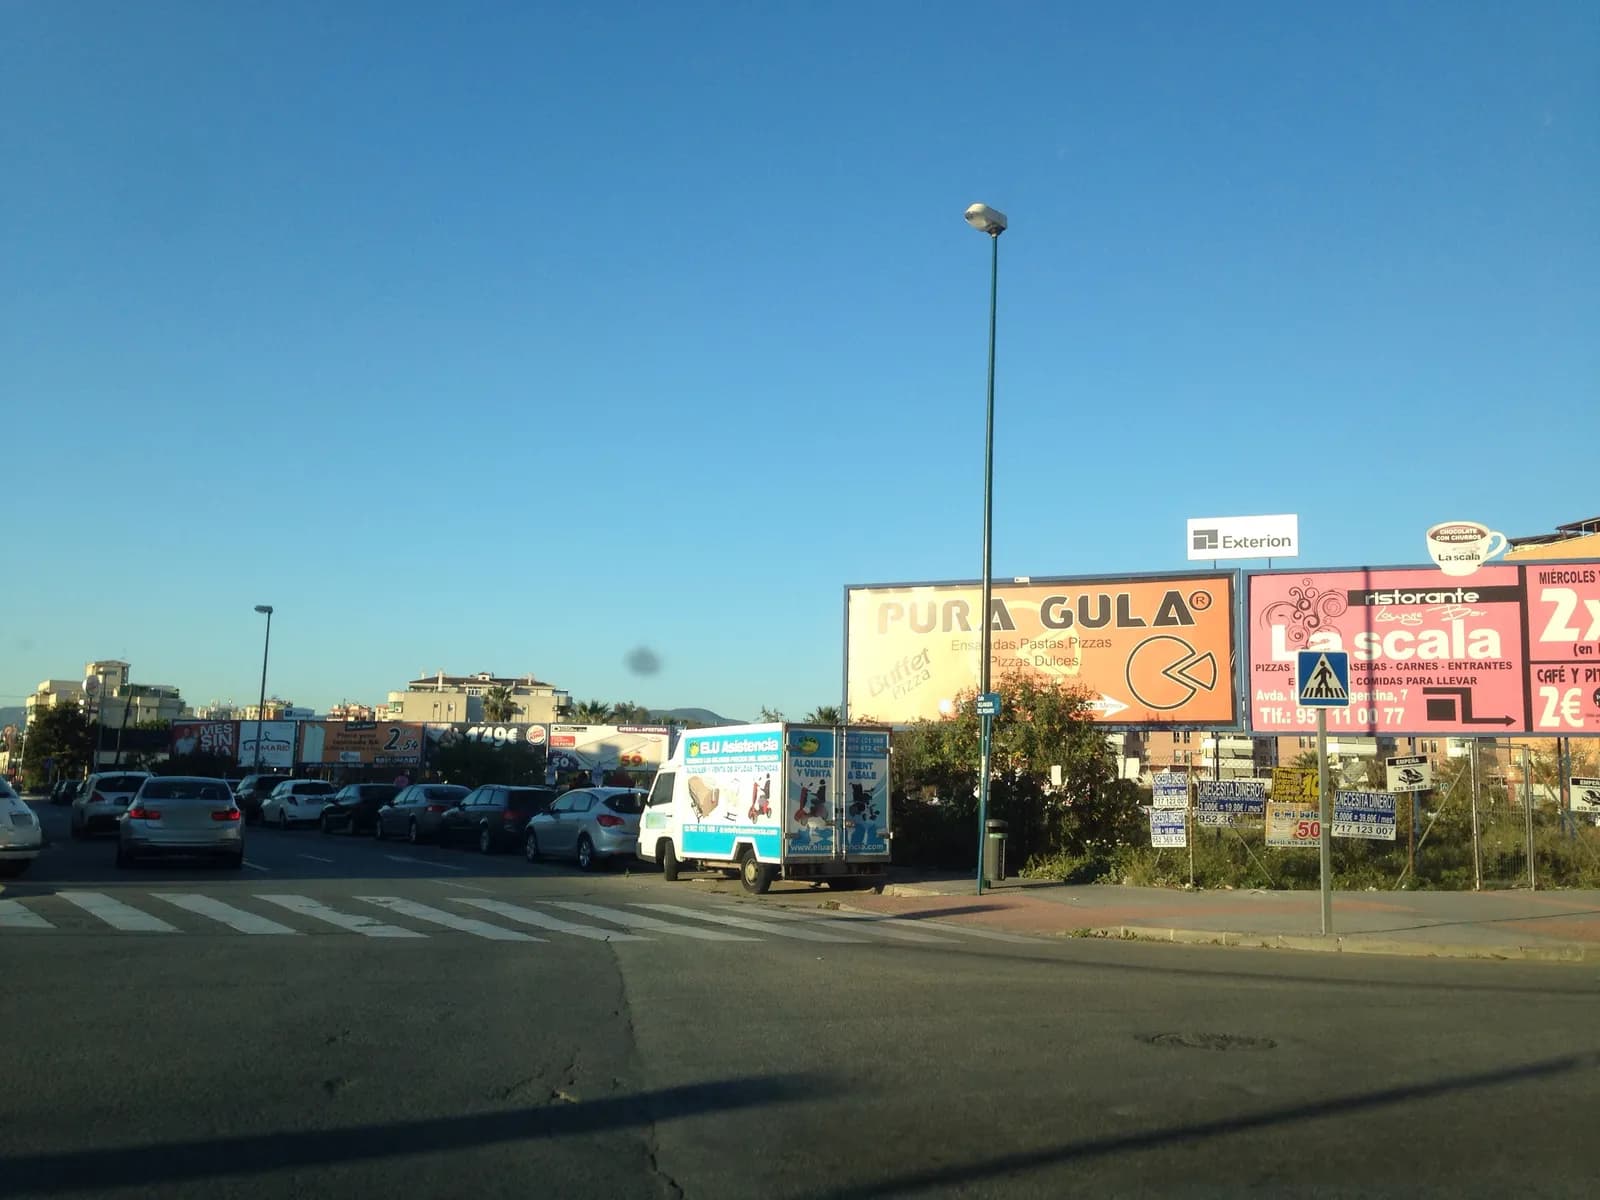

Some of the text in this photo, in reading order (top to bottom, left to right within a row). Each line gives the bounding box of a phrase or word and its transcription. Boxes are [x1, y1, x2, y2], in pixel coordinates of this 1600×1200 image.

[1222, 533, 1292, 549] Exterion
[1438, 552, 1481, 561] La scala
[1539, 568, 1596, 585] MIÉRCOLES
[1365, 587, 1480, 606] ristorante
[878, 598, 1016, 635] PURA
[1353, 618, 1503, 661] scala
[1255, 663, 1291, 672] PIZZAS
[1396, 661, 1439, 671] CARNES
[1447, 660, 1513, 671] ENTRANTES
[1356, 675, 1478, 686] COMIDAS PARA LLEVAR
[1537, 665, 1565, 684] CAFÉ
[1571, 667, 1579, 684] Y
[1256, 690, 1287, 701] Avda.
[1539, 685, 1585, 727] 2€
[1332, 707, 1351, 725] 11
[1357, 707, 1379, 725] 00
[1384, 706, 1405, 724] 77
[200, 723, 233, 735] MES
[201, 734, 233, 748] SIN
[850, 761, 874, 770] RENT
[803, 768, 832, 778] VENTA
[854, 770, 877, 780] SALE
[1334, 823, 1352, 833] 717
[1356, 825, 1373, 834] 123
[1375, 827, 1394, 836] 007
